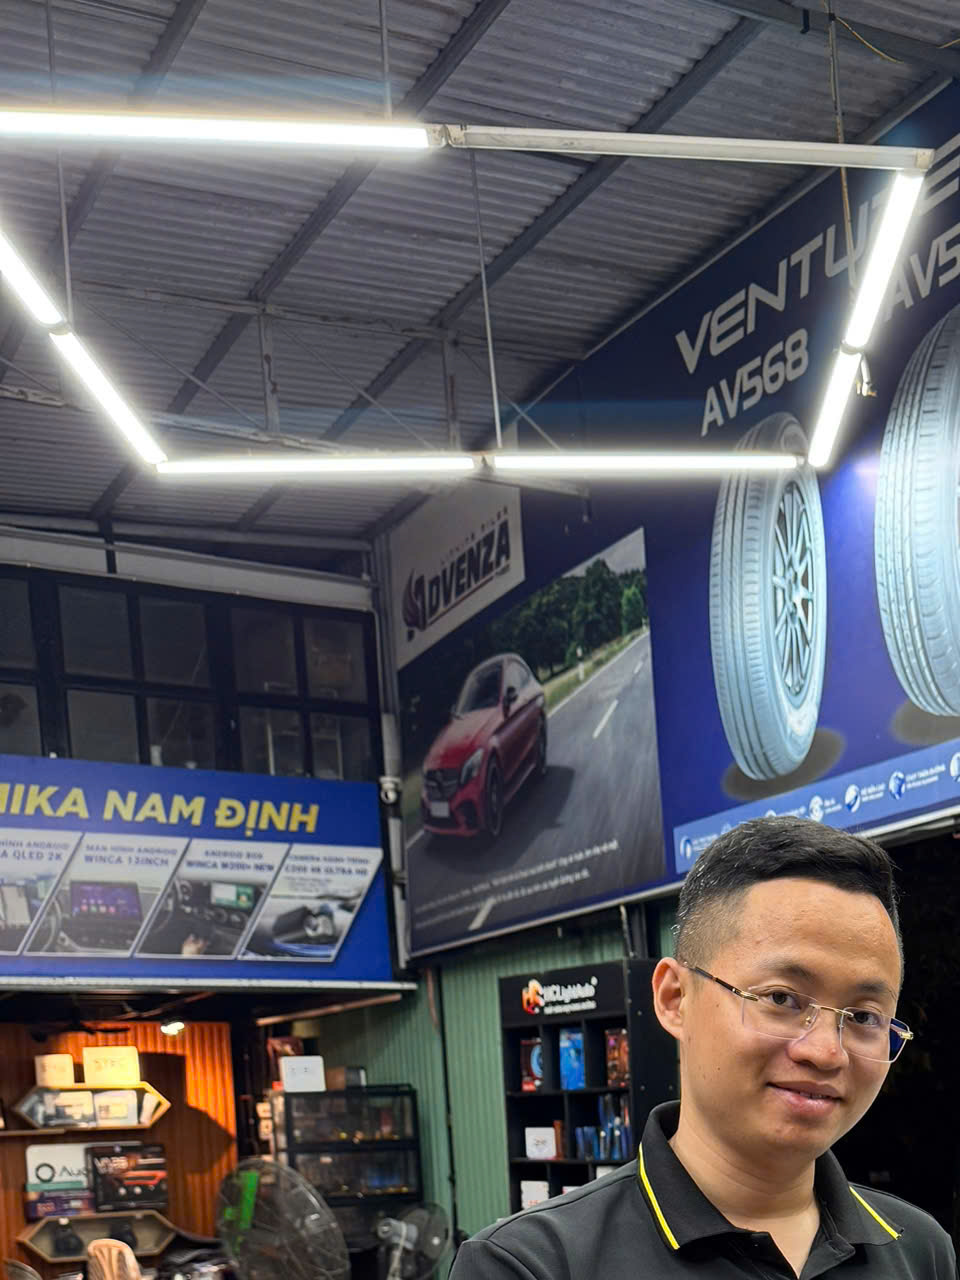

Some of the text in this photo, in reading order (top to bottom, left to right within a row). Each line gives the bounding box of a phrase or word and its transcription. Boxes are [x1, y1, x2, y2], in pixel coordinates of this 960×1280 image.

[701, 328, 809, 437] AV568
[103, 790, 207, 826] NAM
[214, 797, 319, 837] ĐỊNH
